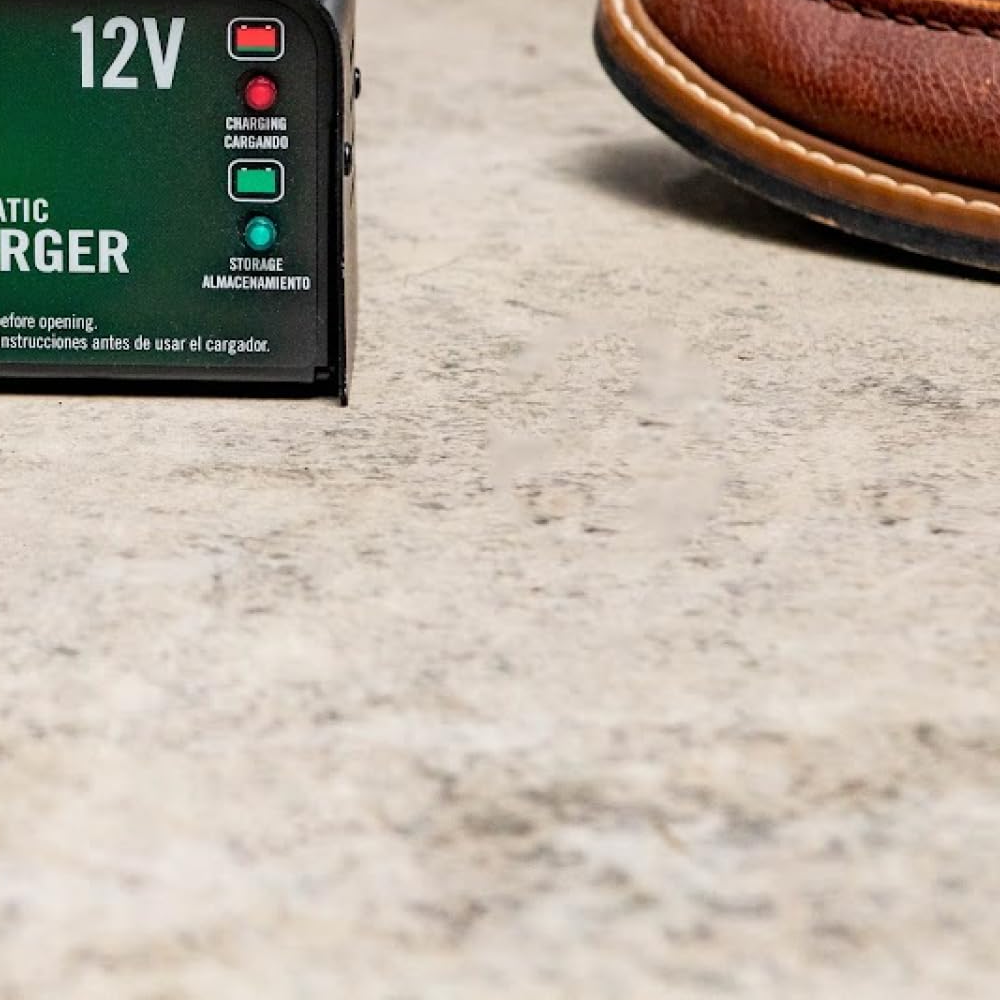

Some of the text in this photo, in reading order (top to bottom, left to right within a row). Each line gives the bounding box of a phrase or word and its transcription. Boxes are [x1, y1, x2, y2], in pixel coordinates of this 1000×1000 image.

[70, 15, 186, 90] 12V
[225, 116, 288, 131] CHARGING
[223, 135, 290, 150] CARGANDO
[229, 257, 284, 272] STORAGE
[201, 275, 312, 291] ALMACENAMIENTO
[38, 314, 98, 332] opening.
[92, 334, 130, 350] antes
[133, 334, 151, 351] de
[154, 336, 186, 352] usar
[189, 335, 202, 352] el
[205, 336, 271, 355] cargador.
